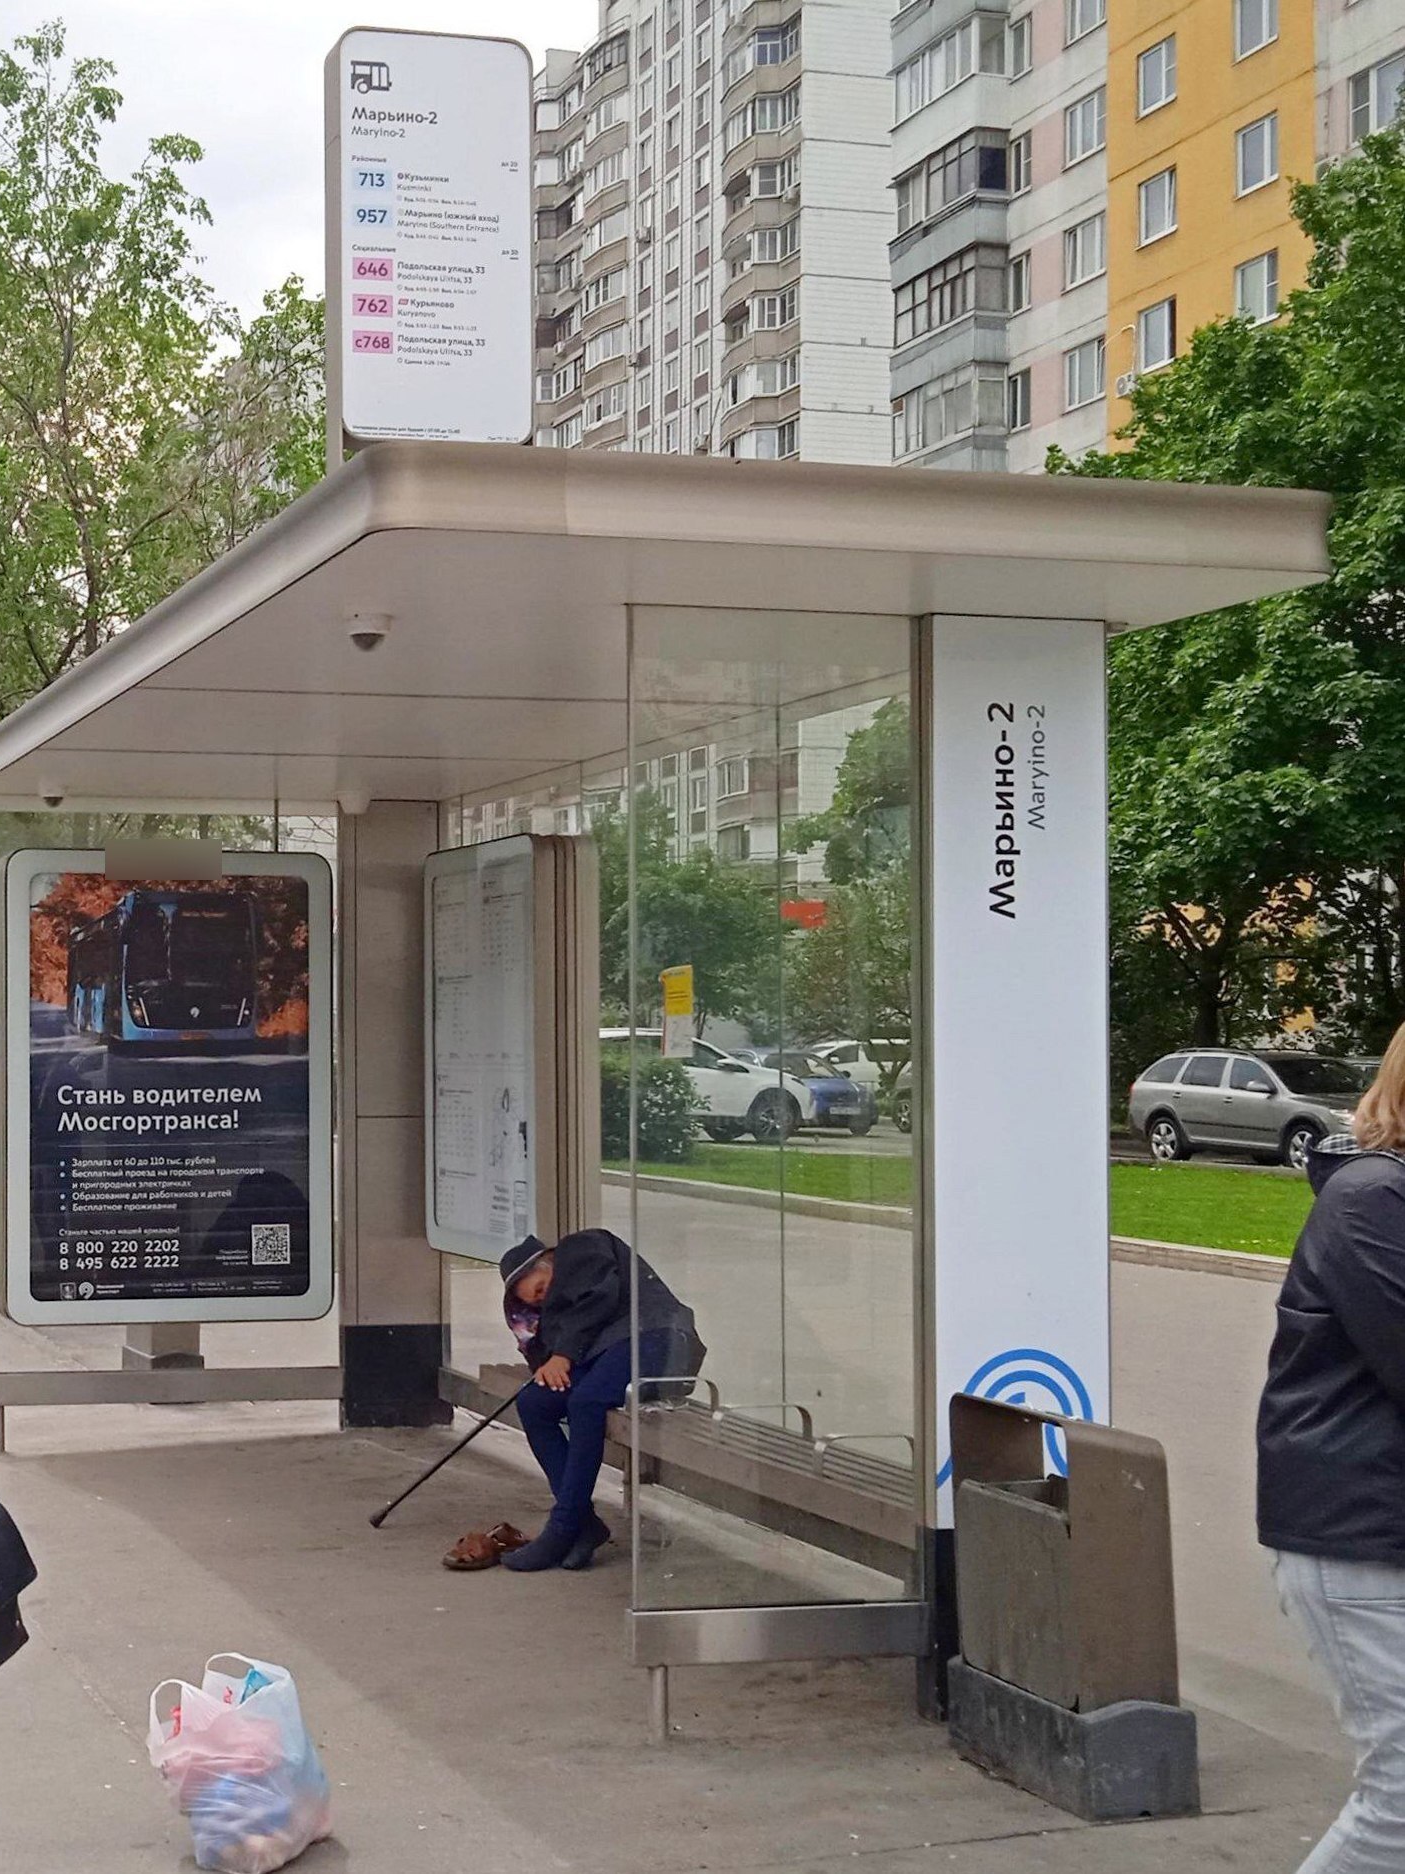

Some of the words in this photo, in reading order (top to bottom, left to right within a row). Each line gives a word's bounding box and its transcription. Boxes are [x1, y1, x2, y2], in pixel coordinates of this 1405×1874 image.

[351, 106, 438, 125] Марьино-2
[351, 126, 406, 139] Maryino-2
[358, 172, 385, 187] 713
[404, 172, 450, 183] Кузьминки
[356, 209, 388, 224] 957
[404, 209, 443, 219] Марьино
[357, 261, 388, 277] 646
[397, 261, 447, 272] Подольская
[475, 265, 486, 275] 33
[397, 272, 438, 282] Podolskaya
[463, 276, 473, 284] 33
[357, 298, 388, 314] 762
[410, 298, 455, 309] Курьяново
[397, 334, 447, 345] Подольская
[475, 338, 486, 347] 33
[397, 345, 438, 355] Podolskaya
[1027, 704, 1050, 831] Maryino-2
[987, 702, 1021, 919] Марьино-2
[57, 1085, 126, 1105] Стань
[133, 1087, 262, 1107] водителем
[57, 1109, 240, 1135] Мосгортранса!
[72, 1158, 112, 1167] Зарплата
[124, 1157, 136, 1166] 60
[150, 1157, 164, 1165] 110
[185, 1156, 216, 1167] рублей
[72, 1169, 123, 1178] Бесплатный
[125, 1169, 156, 1178] проезд
[169, 1168, 214, 1177] городском
[216, 1167, 264, 1176] транспорте
[79, 1181, 136, 1190] пригородных
[138, 1180, 192, 1188] электричках
[72, 1192, 130, 1201] Образование
[131, 1192, 148, 1200] для
[149, 1190, 199, 1200] работников
[207, 1189, 232, 1198] детей
[72, 1203, 123, 1212] Бесплатное
[124, 1203, 177, 1211] проживание
[59, 1242, 69, 1254] 8
[76, 1241, 104, 1254] 800
[111, 1240, 138, 1253] 220
[144, 1239, 180, 1252] 2202
[59, 1258, 69, 1270] 8
[76, 1257, 103, 1270] 495
[110, 1255, 138, 1269] 622
[144, 1255, 180, 1268] 2222
